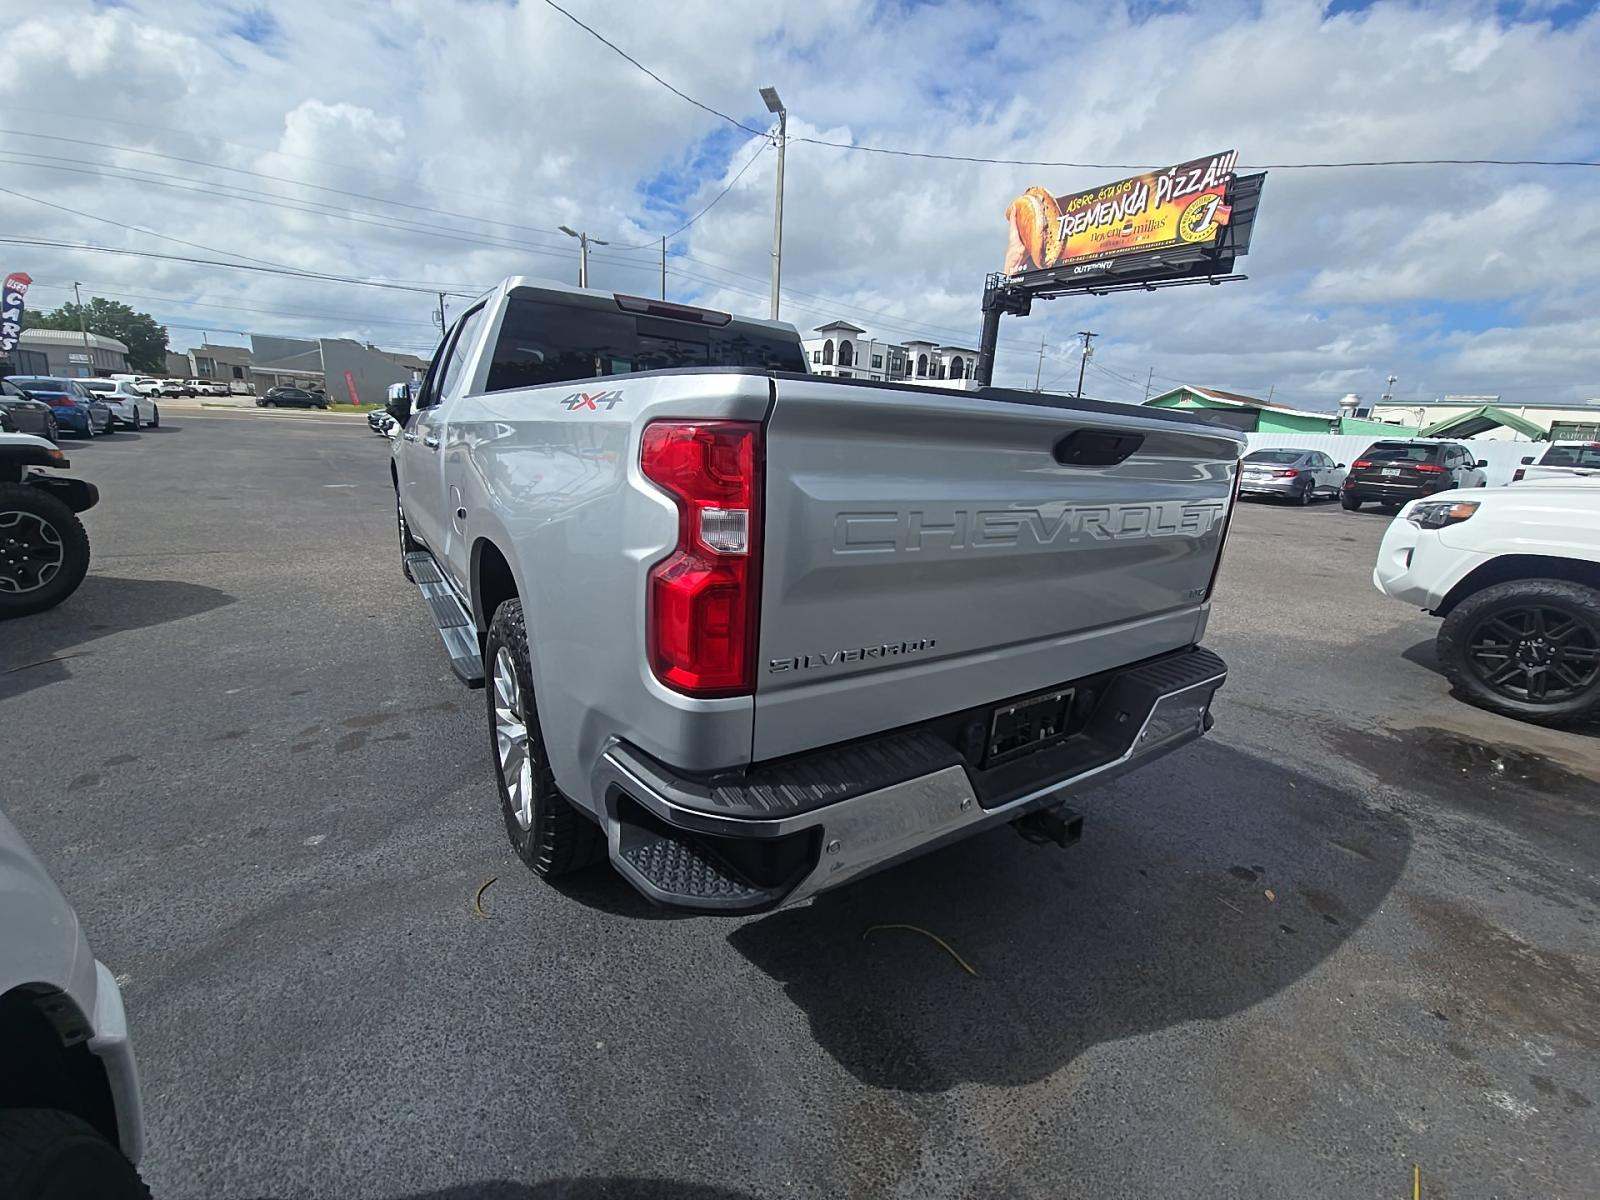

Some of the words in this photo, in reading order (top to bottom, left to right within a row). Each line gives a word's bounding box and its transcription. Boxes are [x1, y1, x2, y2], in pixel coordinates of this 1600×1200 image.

[6, 278, 28, 294] USED
[2, 292, 22, 350] CARS
[833, 503, 1224, 554] CHEVROLET
[769, 638, 937, 674] SILVERADO
